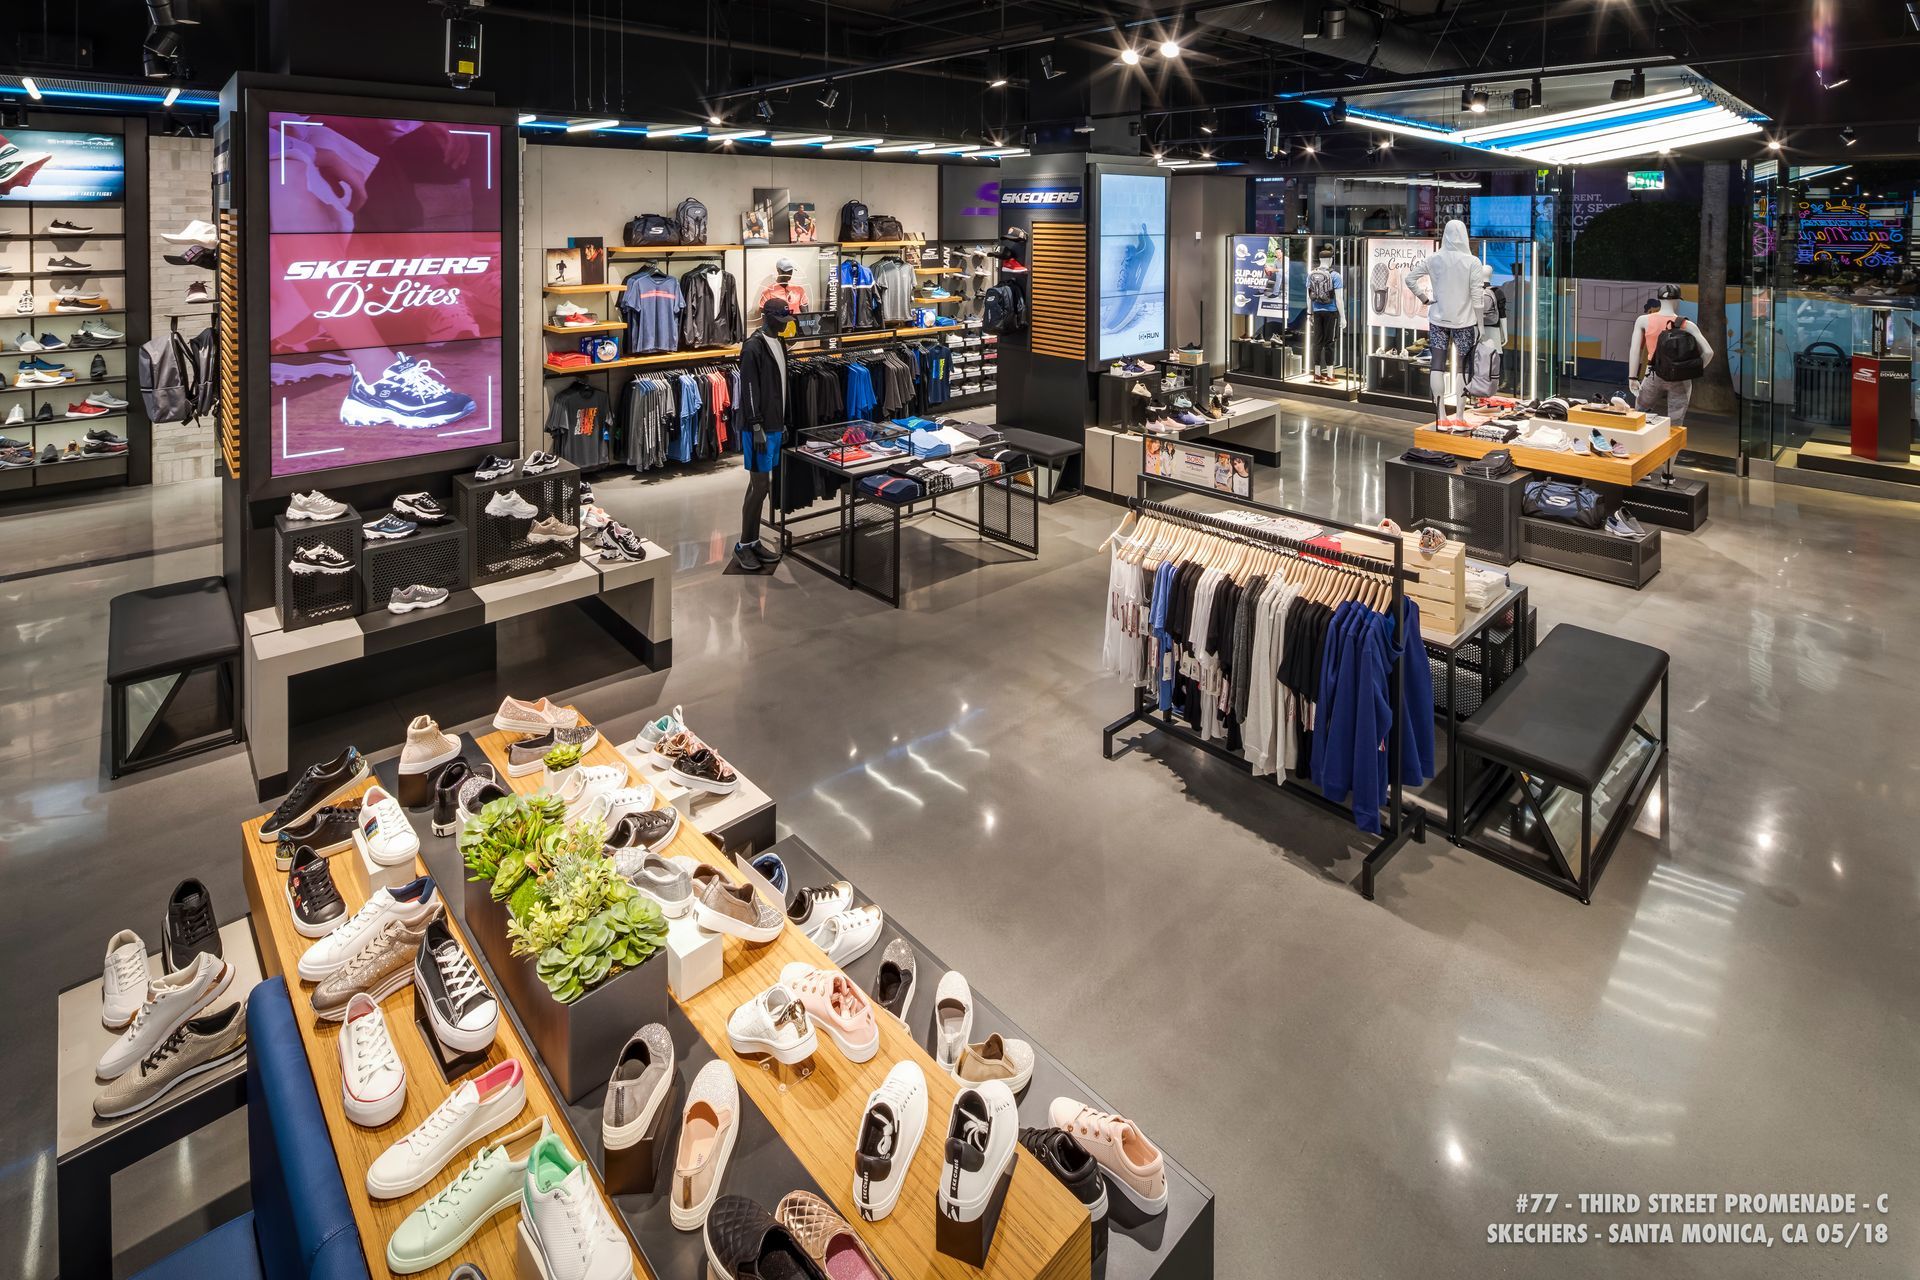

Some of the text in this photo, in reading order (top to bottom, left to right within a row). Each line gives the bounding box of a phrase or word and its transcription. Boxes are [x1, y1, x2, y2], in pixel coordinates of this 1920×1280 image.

[1635, 171, 1658, 188] EXIT
[1001, 191, 1080, 204] SKECHERS
[1374, 248, 1426, 258] SPARKLE IN
[283, 256, 491, 281] SKECHERS
[1388, 255, 1422, 271] Comfo
[1234, 269, 1263, 278] SLIP-ON
[829, 263, 839, 311] MANAGEMENT
[1234, 277, 1268, 286] COMFORT
